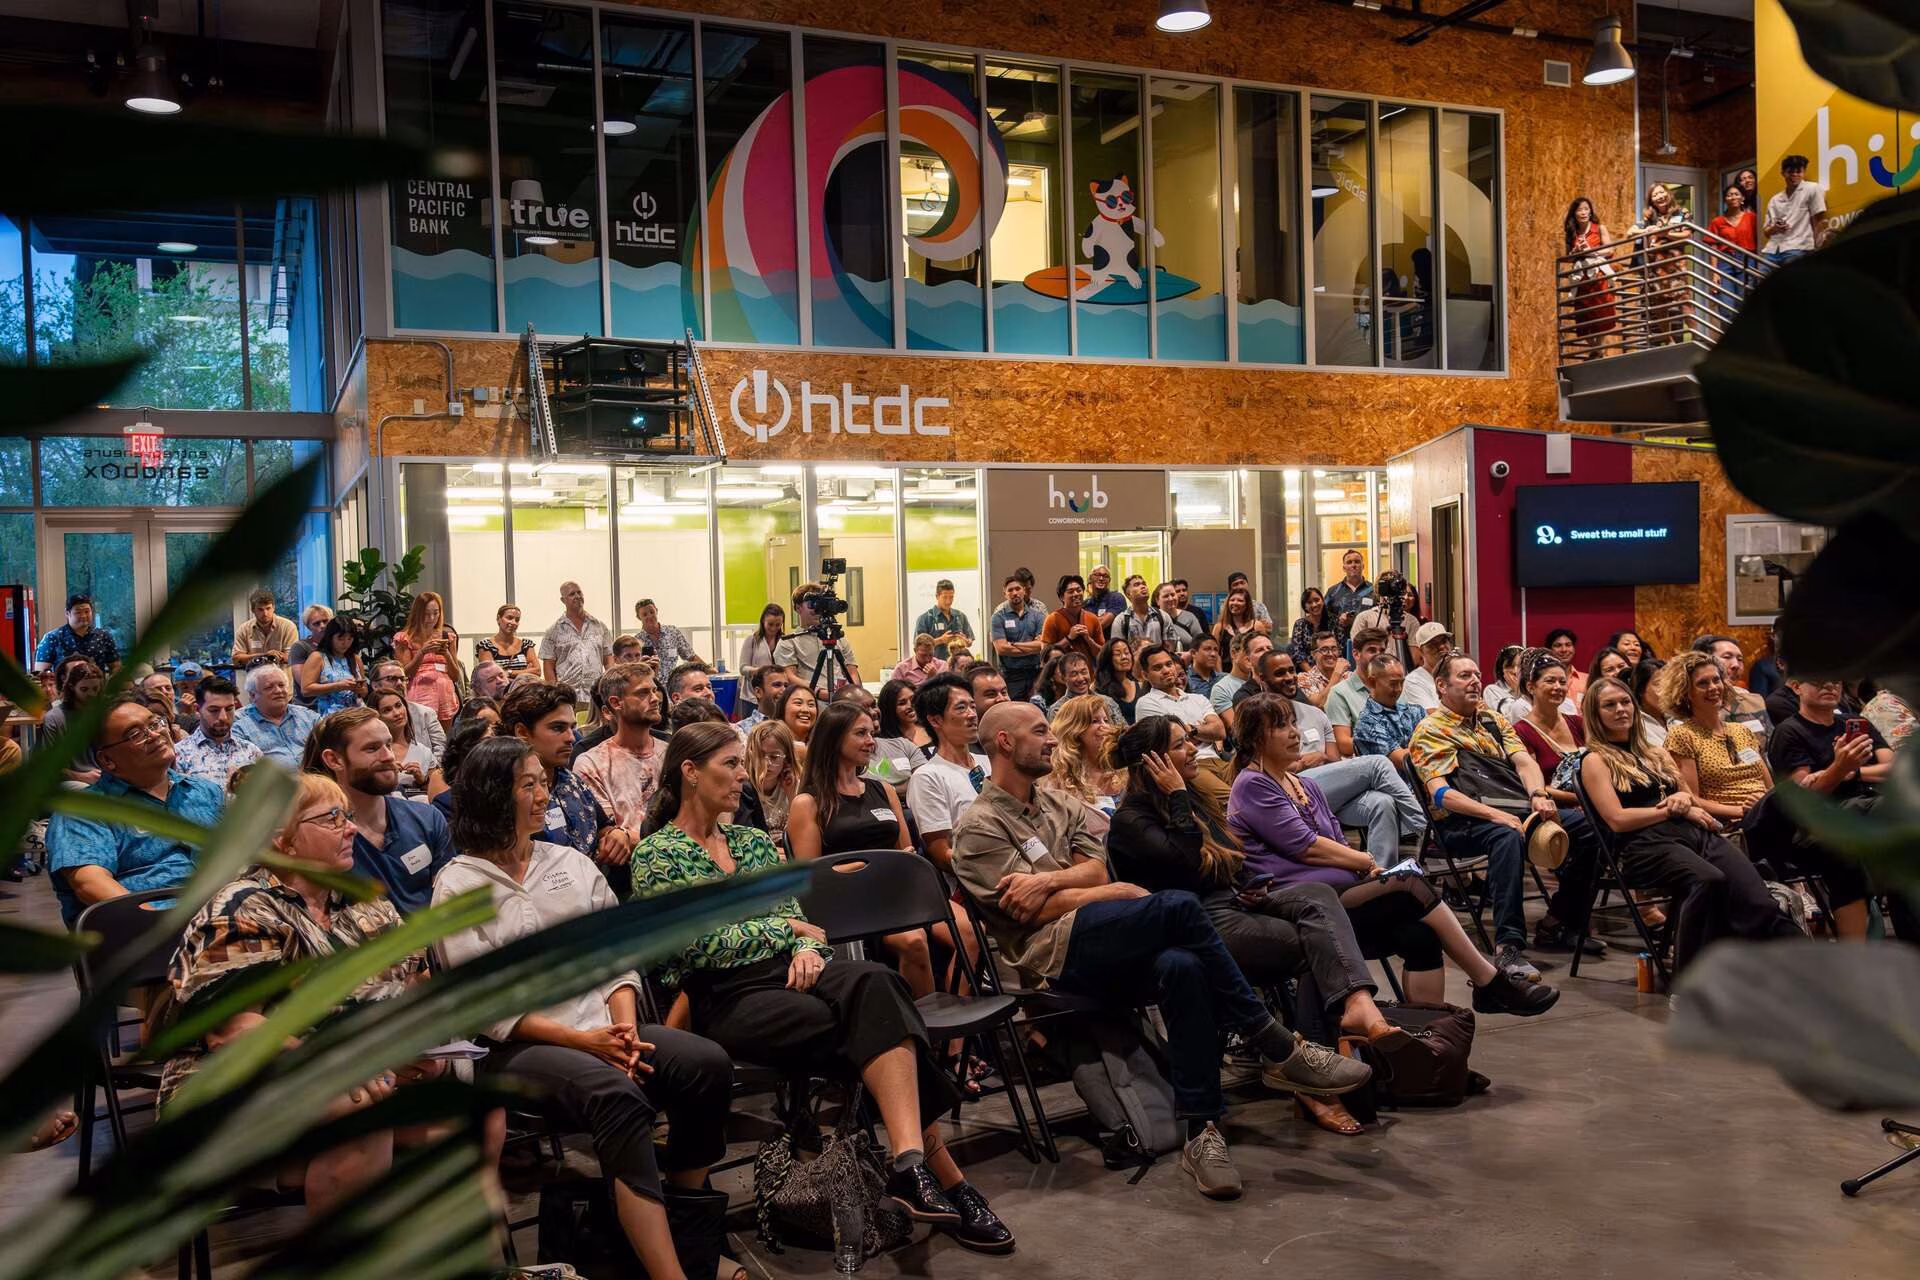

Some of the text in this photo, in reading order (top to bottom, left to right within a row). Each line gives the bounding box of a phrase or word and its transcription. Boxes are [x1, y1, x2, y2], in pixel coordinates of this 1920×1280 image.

[408, 179, 473, 199] CENTRAL
[409, 198, 465, 217] PACIFIC
[511, 200, 590, 228] true
[410, 217, 449, 235] BANK
[616, 220, 676, 244] htdc
[801, 381, 950, 436] htdc
[132, 435, 158, 453] EXIT
[1049, 474, 1109, 513] hub
[1536, 525, 1668, 544] 9. Sweat the small stuff
